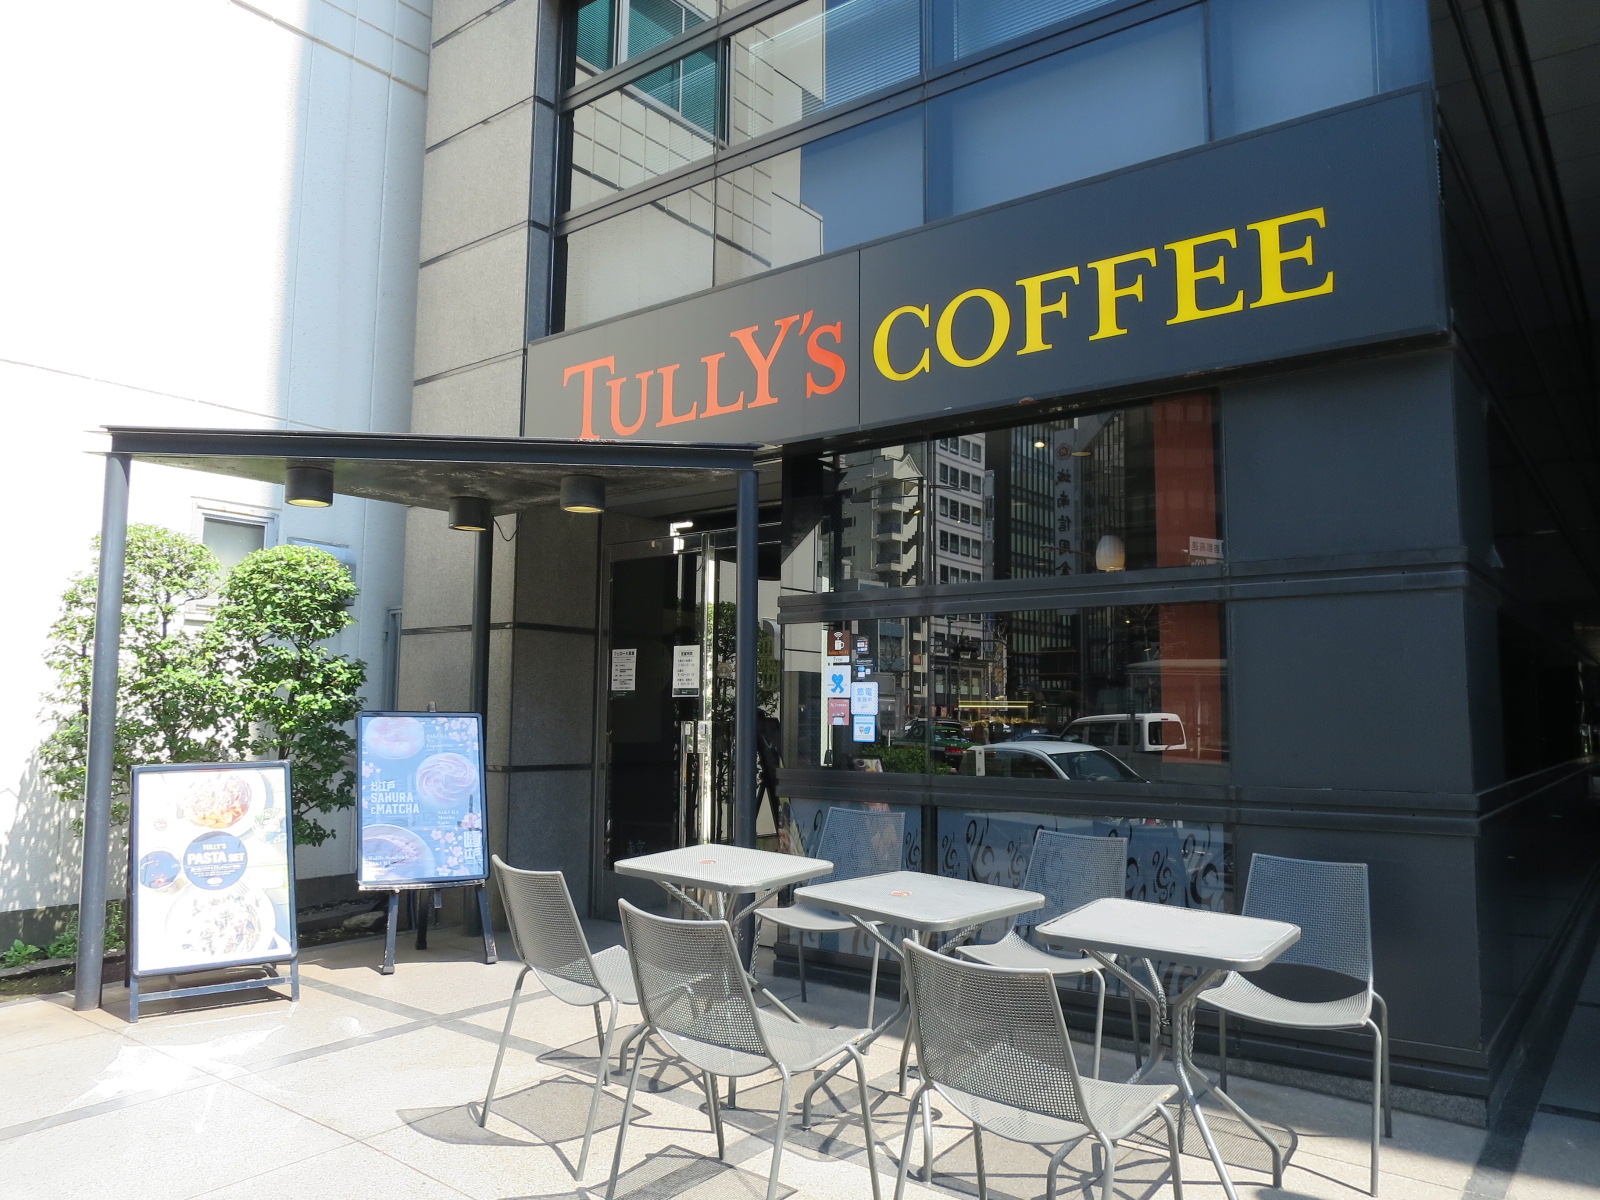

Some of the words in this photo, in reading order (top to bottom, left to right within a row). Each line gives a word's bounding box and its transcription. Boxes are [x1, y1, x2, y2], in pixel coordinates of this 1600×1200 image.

[563, 310, 847, 441] TULLY'S
[872, 206, 1335, 382] COFFEE
[370, 792, 414, 803] SAKURA
[202, 843, 227, 851] TULLY'S
[187, 851, 227, 866] PASTA
[228, 852, 245, 863] SET
